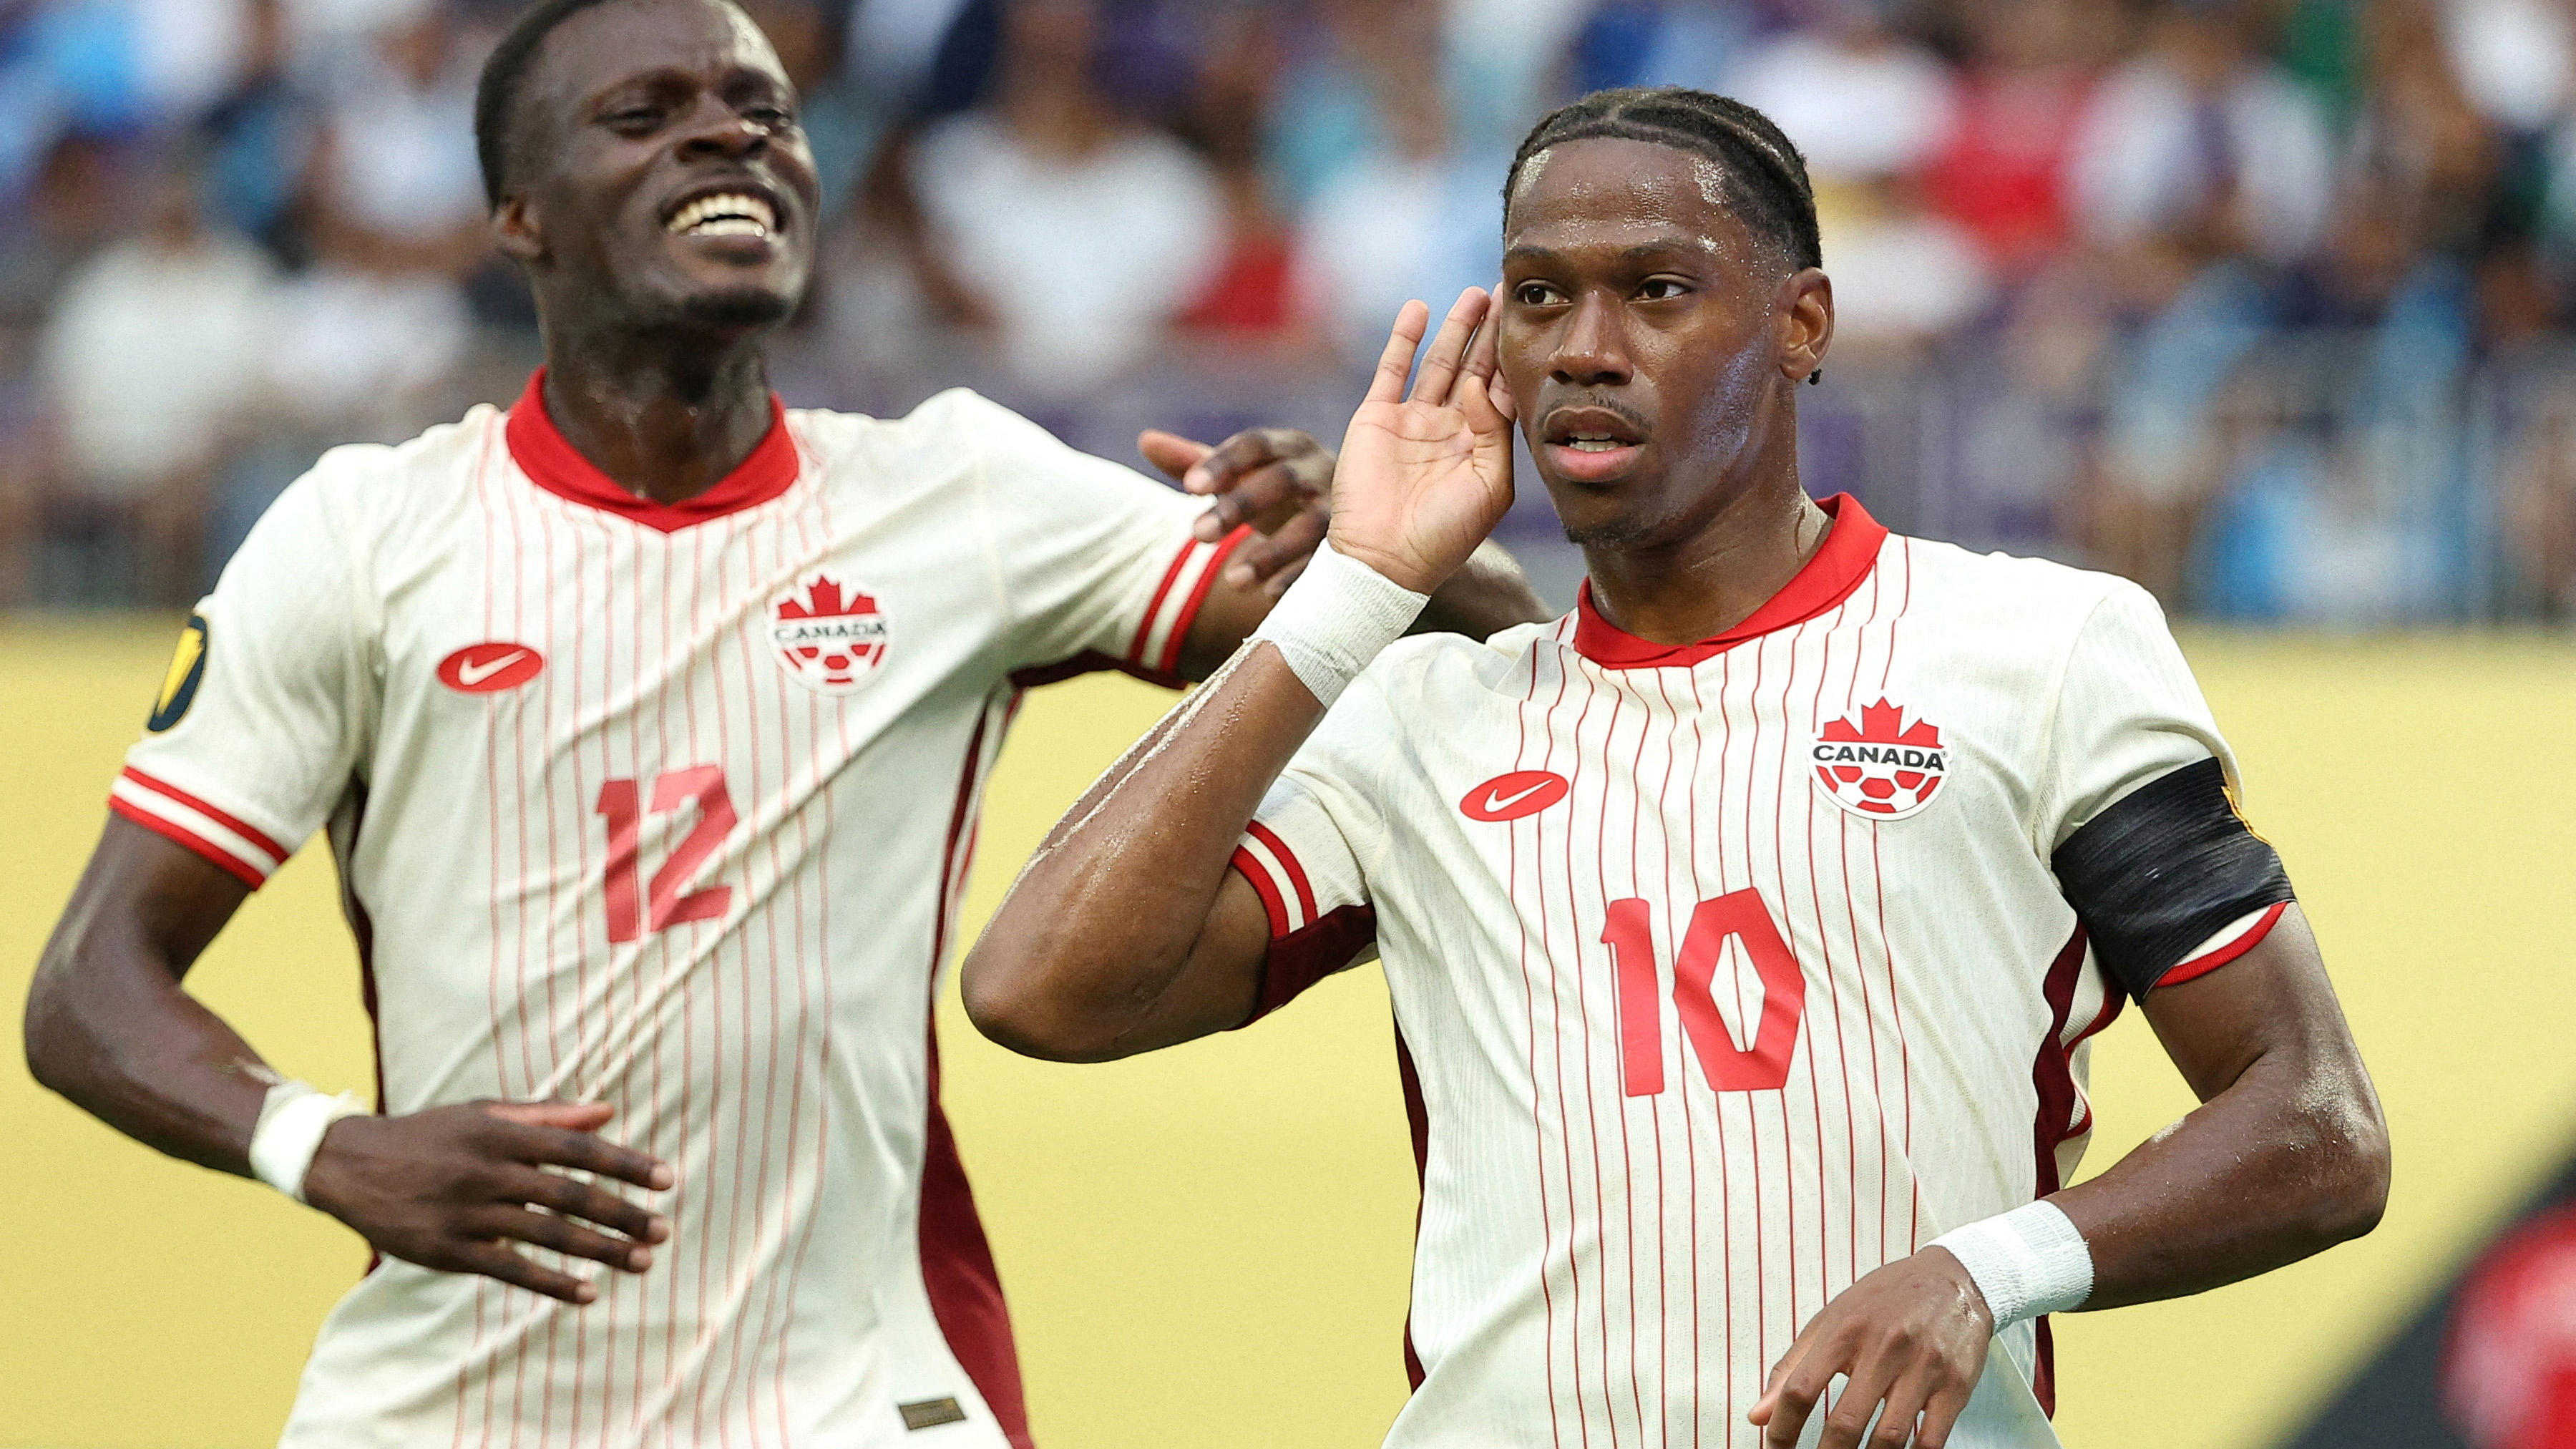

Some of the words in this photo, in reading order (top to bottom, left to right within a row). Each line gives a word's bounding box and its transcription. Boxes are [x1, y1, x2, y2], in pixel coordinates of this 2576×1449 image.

[775, 622, 886, 640] CANADA
[1813, 745, 1945, 771] CANADA
[597, 764, 737, 943] 12
[1600, 887, 1806, 1097] 10
